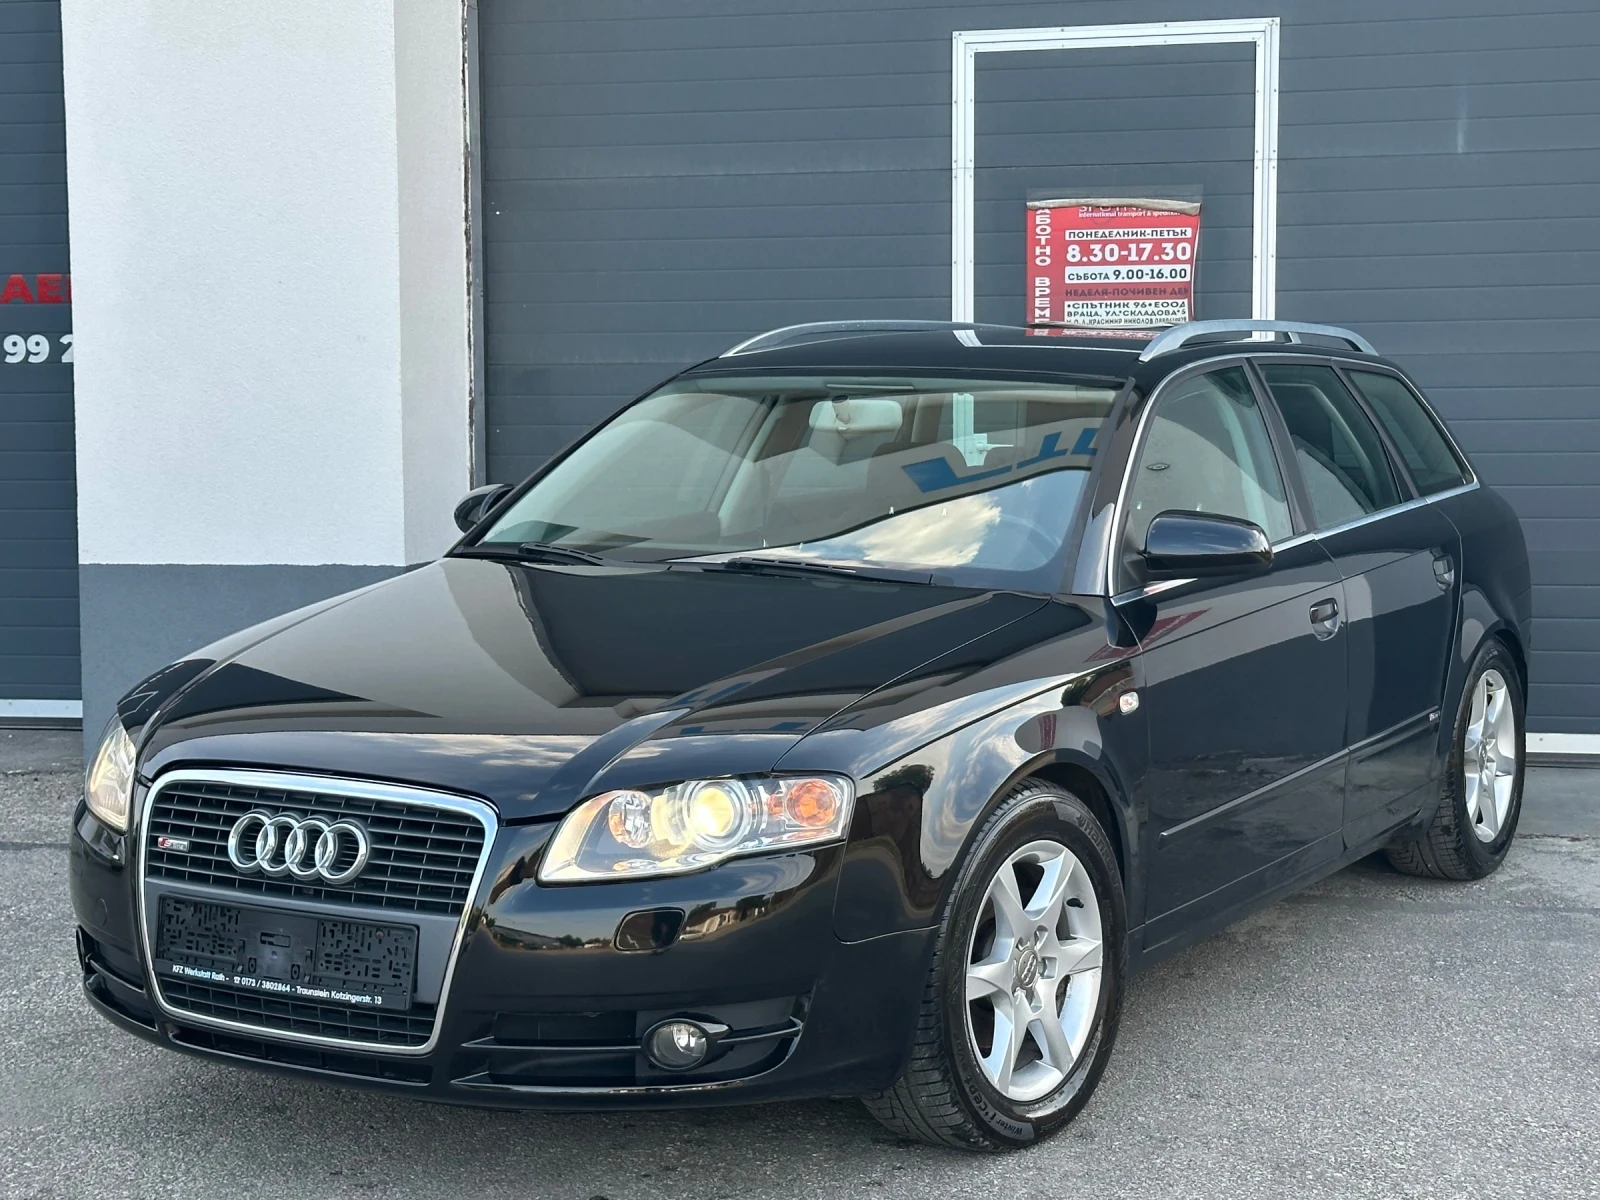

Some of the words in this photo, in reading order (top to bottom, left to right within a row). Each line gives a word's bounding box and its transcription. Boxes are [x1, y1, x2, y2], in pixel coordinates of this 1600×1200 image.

[1117, 210, 1146, 219] transport
[1068, 229, 1188, 239] ПОНЕДЕЛНИК-ПЕТЪК
[1066, 242, 1191, 262] 8.30-17.30
[1067, 273, 1110, 281] СЪБОТА
[1112, 268, 1188, 280] 9.00-16.00
[1065, 287, 1167, 297] НЕДЕЛЯ-ПОЧИВЕН
[3, 334, 50, 364] 99
[172, 964, 184, 974] KFZ
[184, 967, 211, 979] Werkstatt
[241, 977, 256, 988] 0173
[262, 980, 291, 993] 3802864
[296, 986, 330, 998] Traunstein
[374, 996, 382, 1004] 13
[996, 1119, 1023, 1136] Winter
